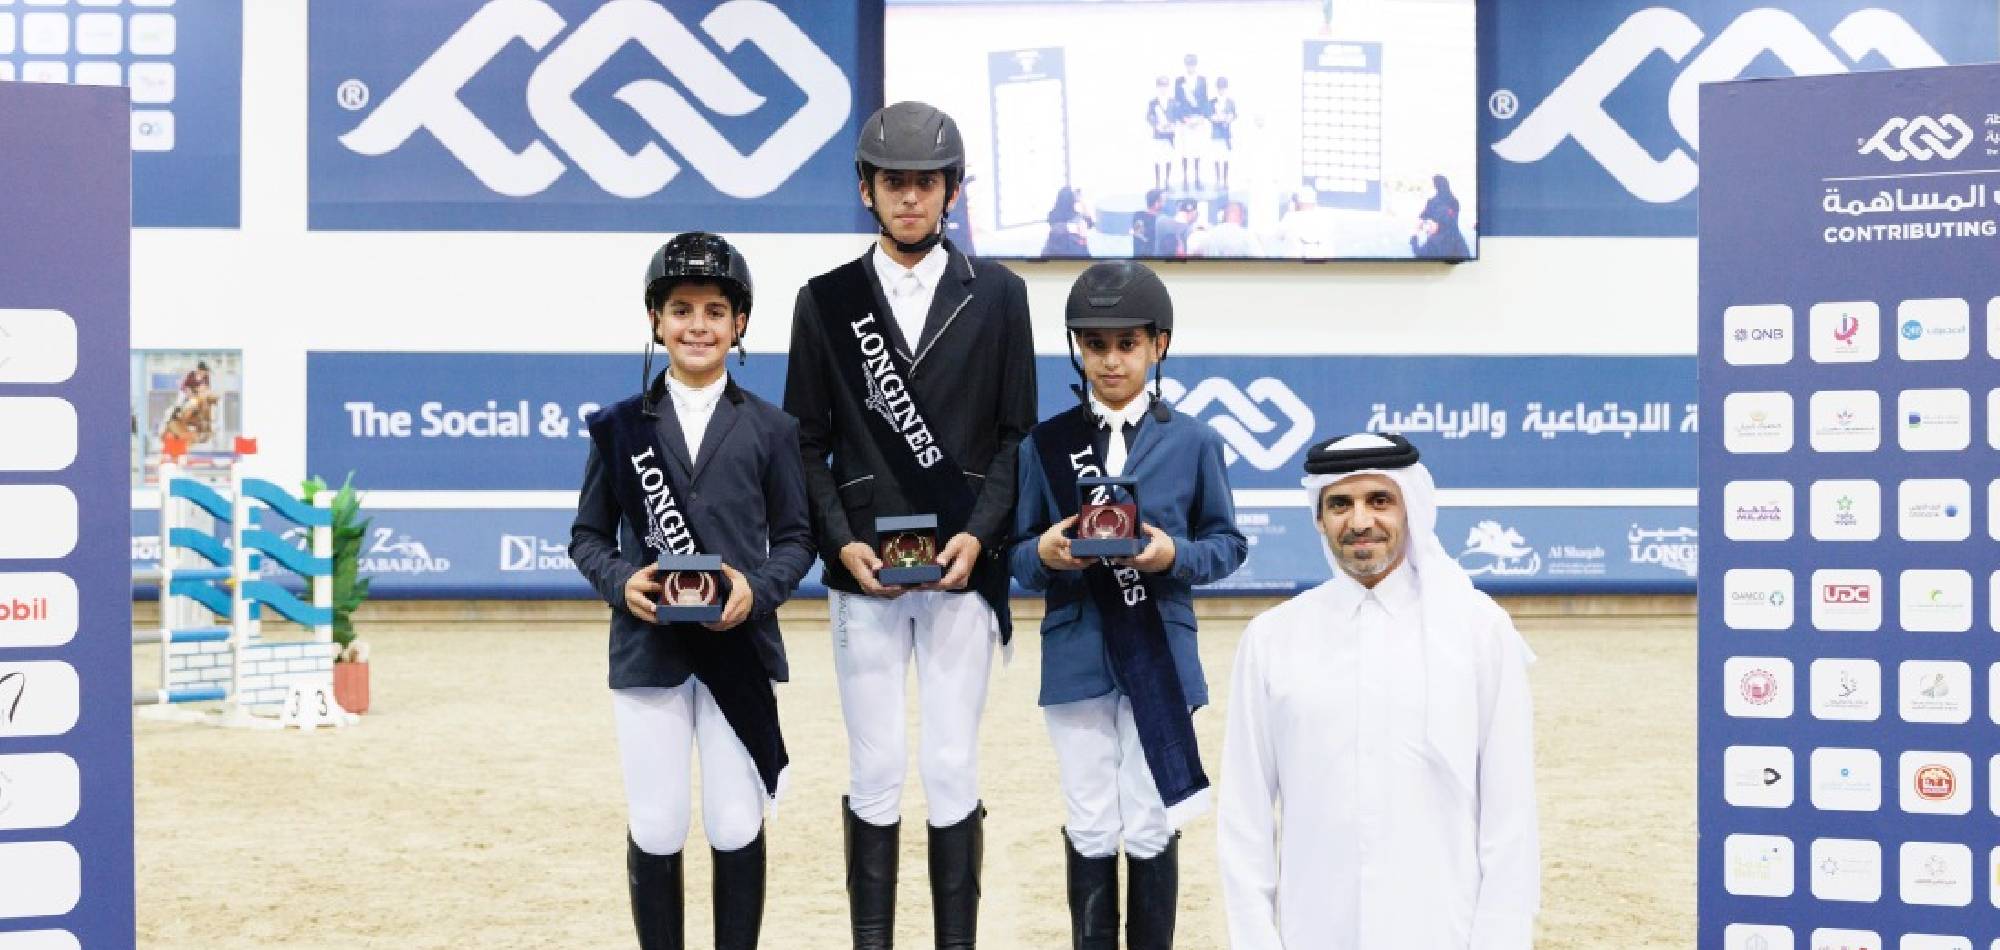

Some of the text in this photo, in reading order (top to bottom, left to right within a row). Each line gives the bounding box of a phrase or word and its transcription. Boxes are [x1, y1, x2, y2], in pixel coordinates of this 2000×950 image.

[1823, 184, 1986, 216] المساهمة
[1824, 220, 1997, 243] CONTRIBUTING
[1751, 328, 1784, 341] QNB
[850, 312, 944, 469] LONGINES
[344, 402, 412, 437] The
[421, 400, 530, 437] Social
[539, 402, 569, 437] &
[1366, 402, 1507, 439] والرياضية
[1522, 402, 1670, 439] الاجتماعية
